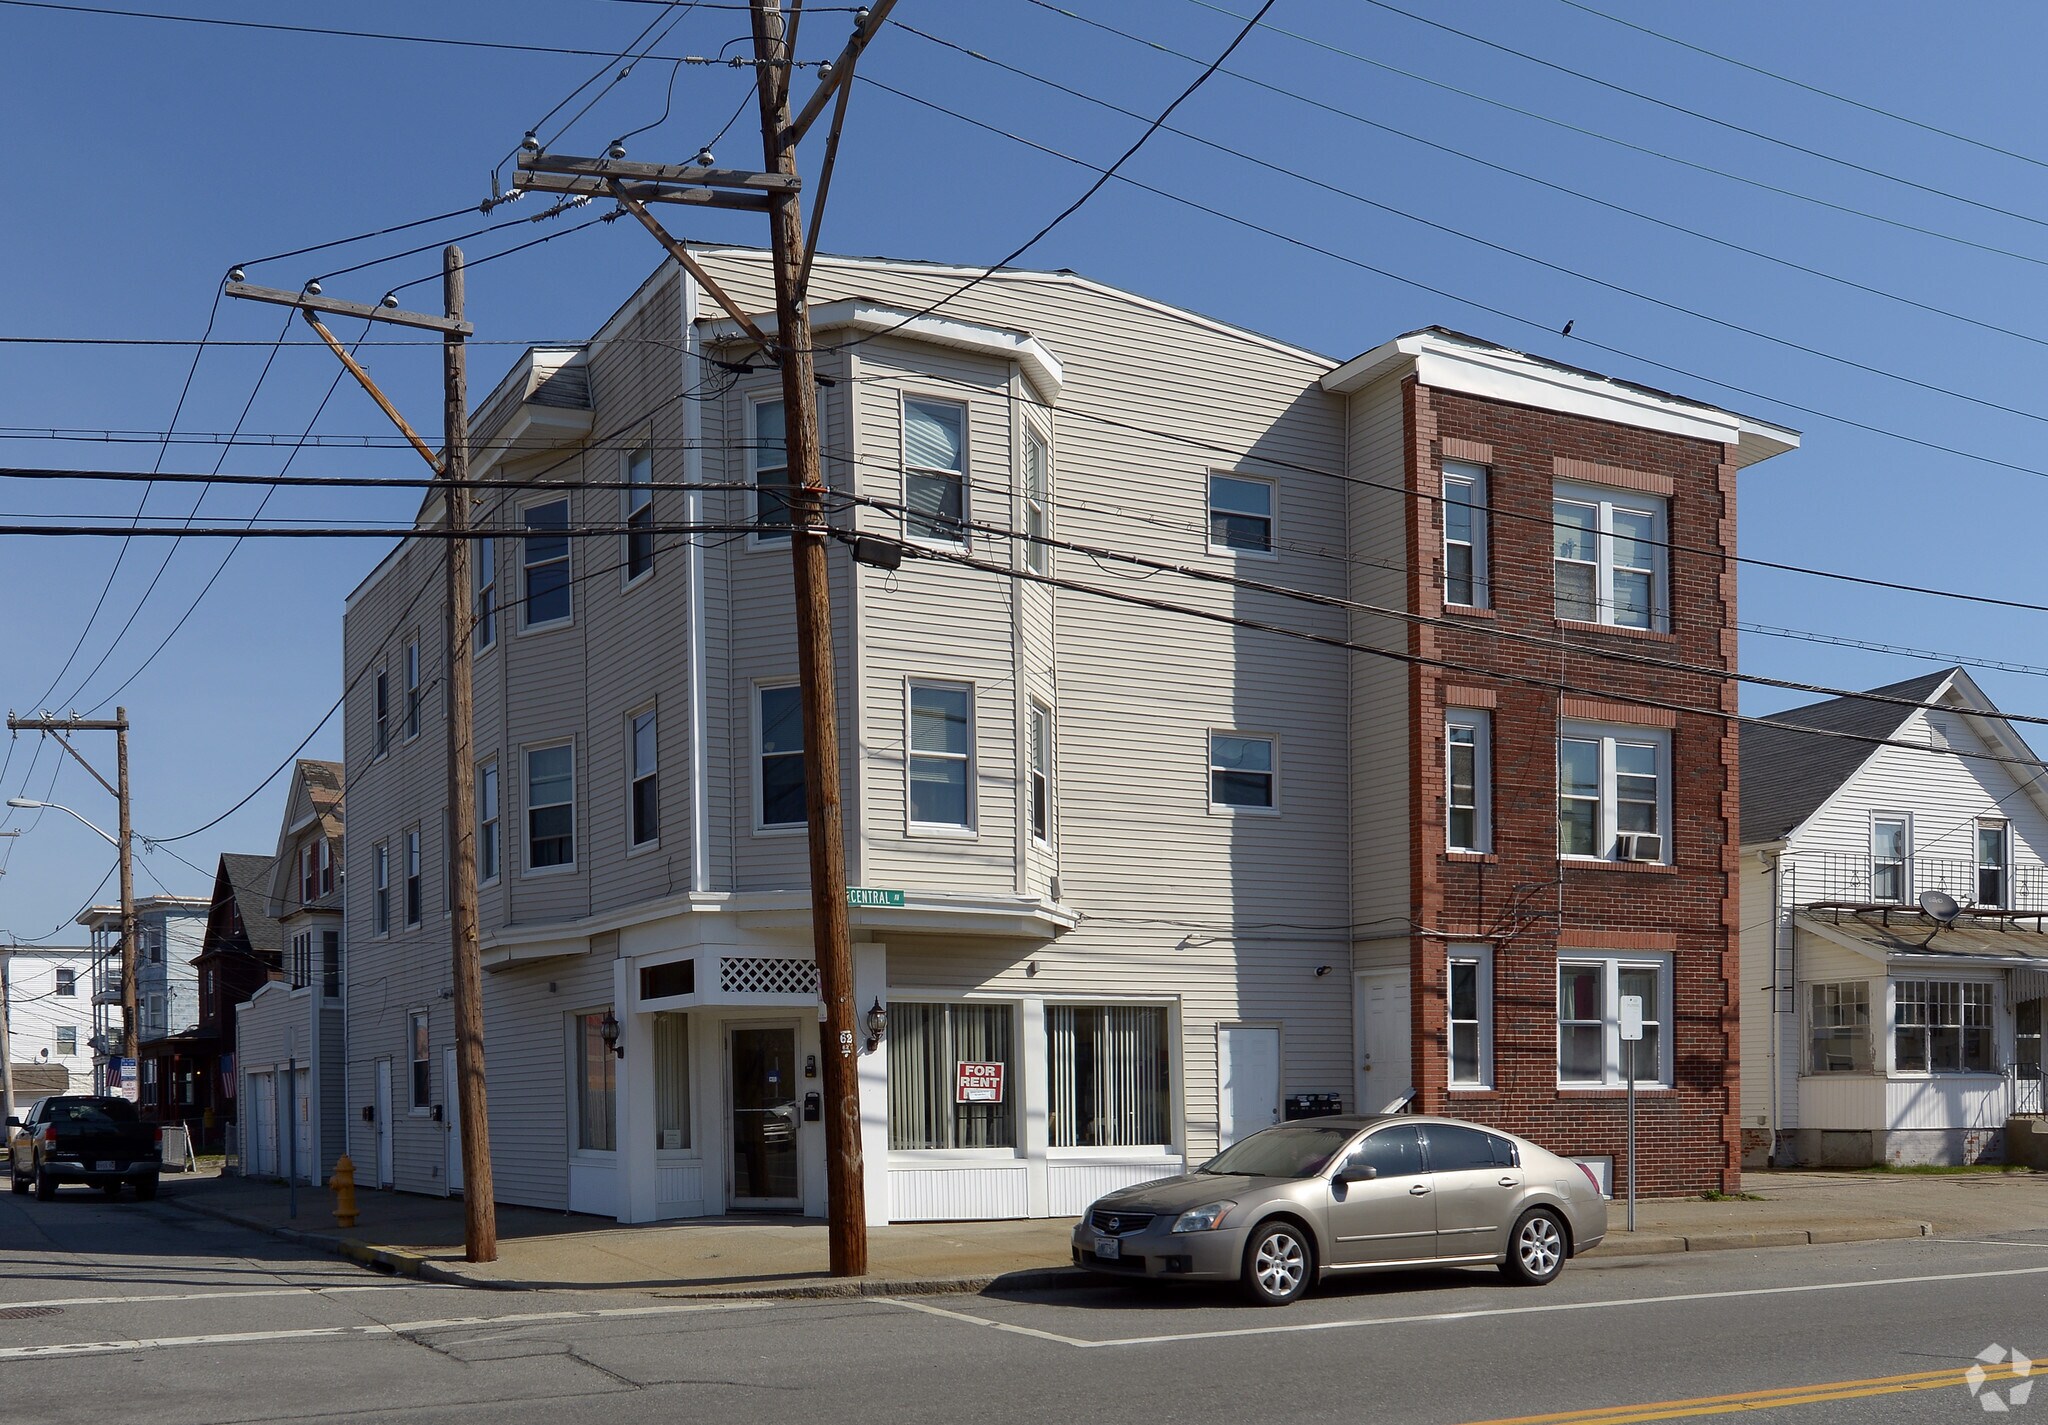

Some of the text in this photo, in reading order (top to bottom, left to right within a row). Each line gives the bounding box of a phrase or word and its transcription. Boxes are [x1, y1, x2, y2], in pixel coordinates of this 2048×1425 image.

[850, 890, 891, 904] CENTRAL
[840, 1033, 853, 1044] 62
[965, 1065, 996, 1076] FOR
[960, 1076, 1000, 1088] RENT
